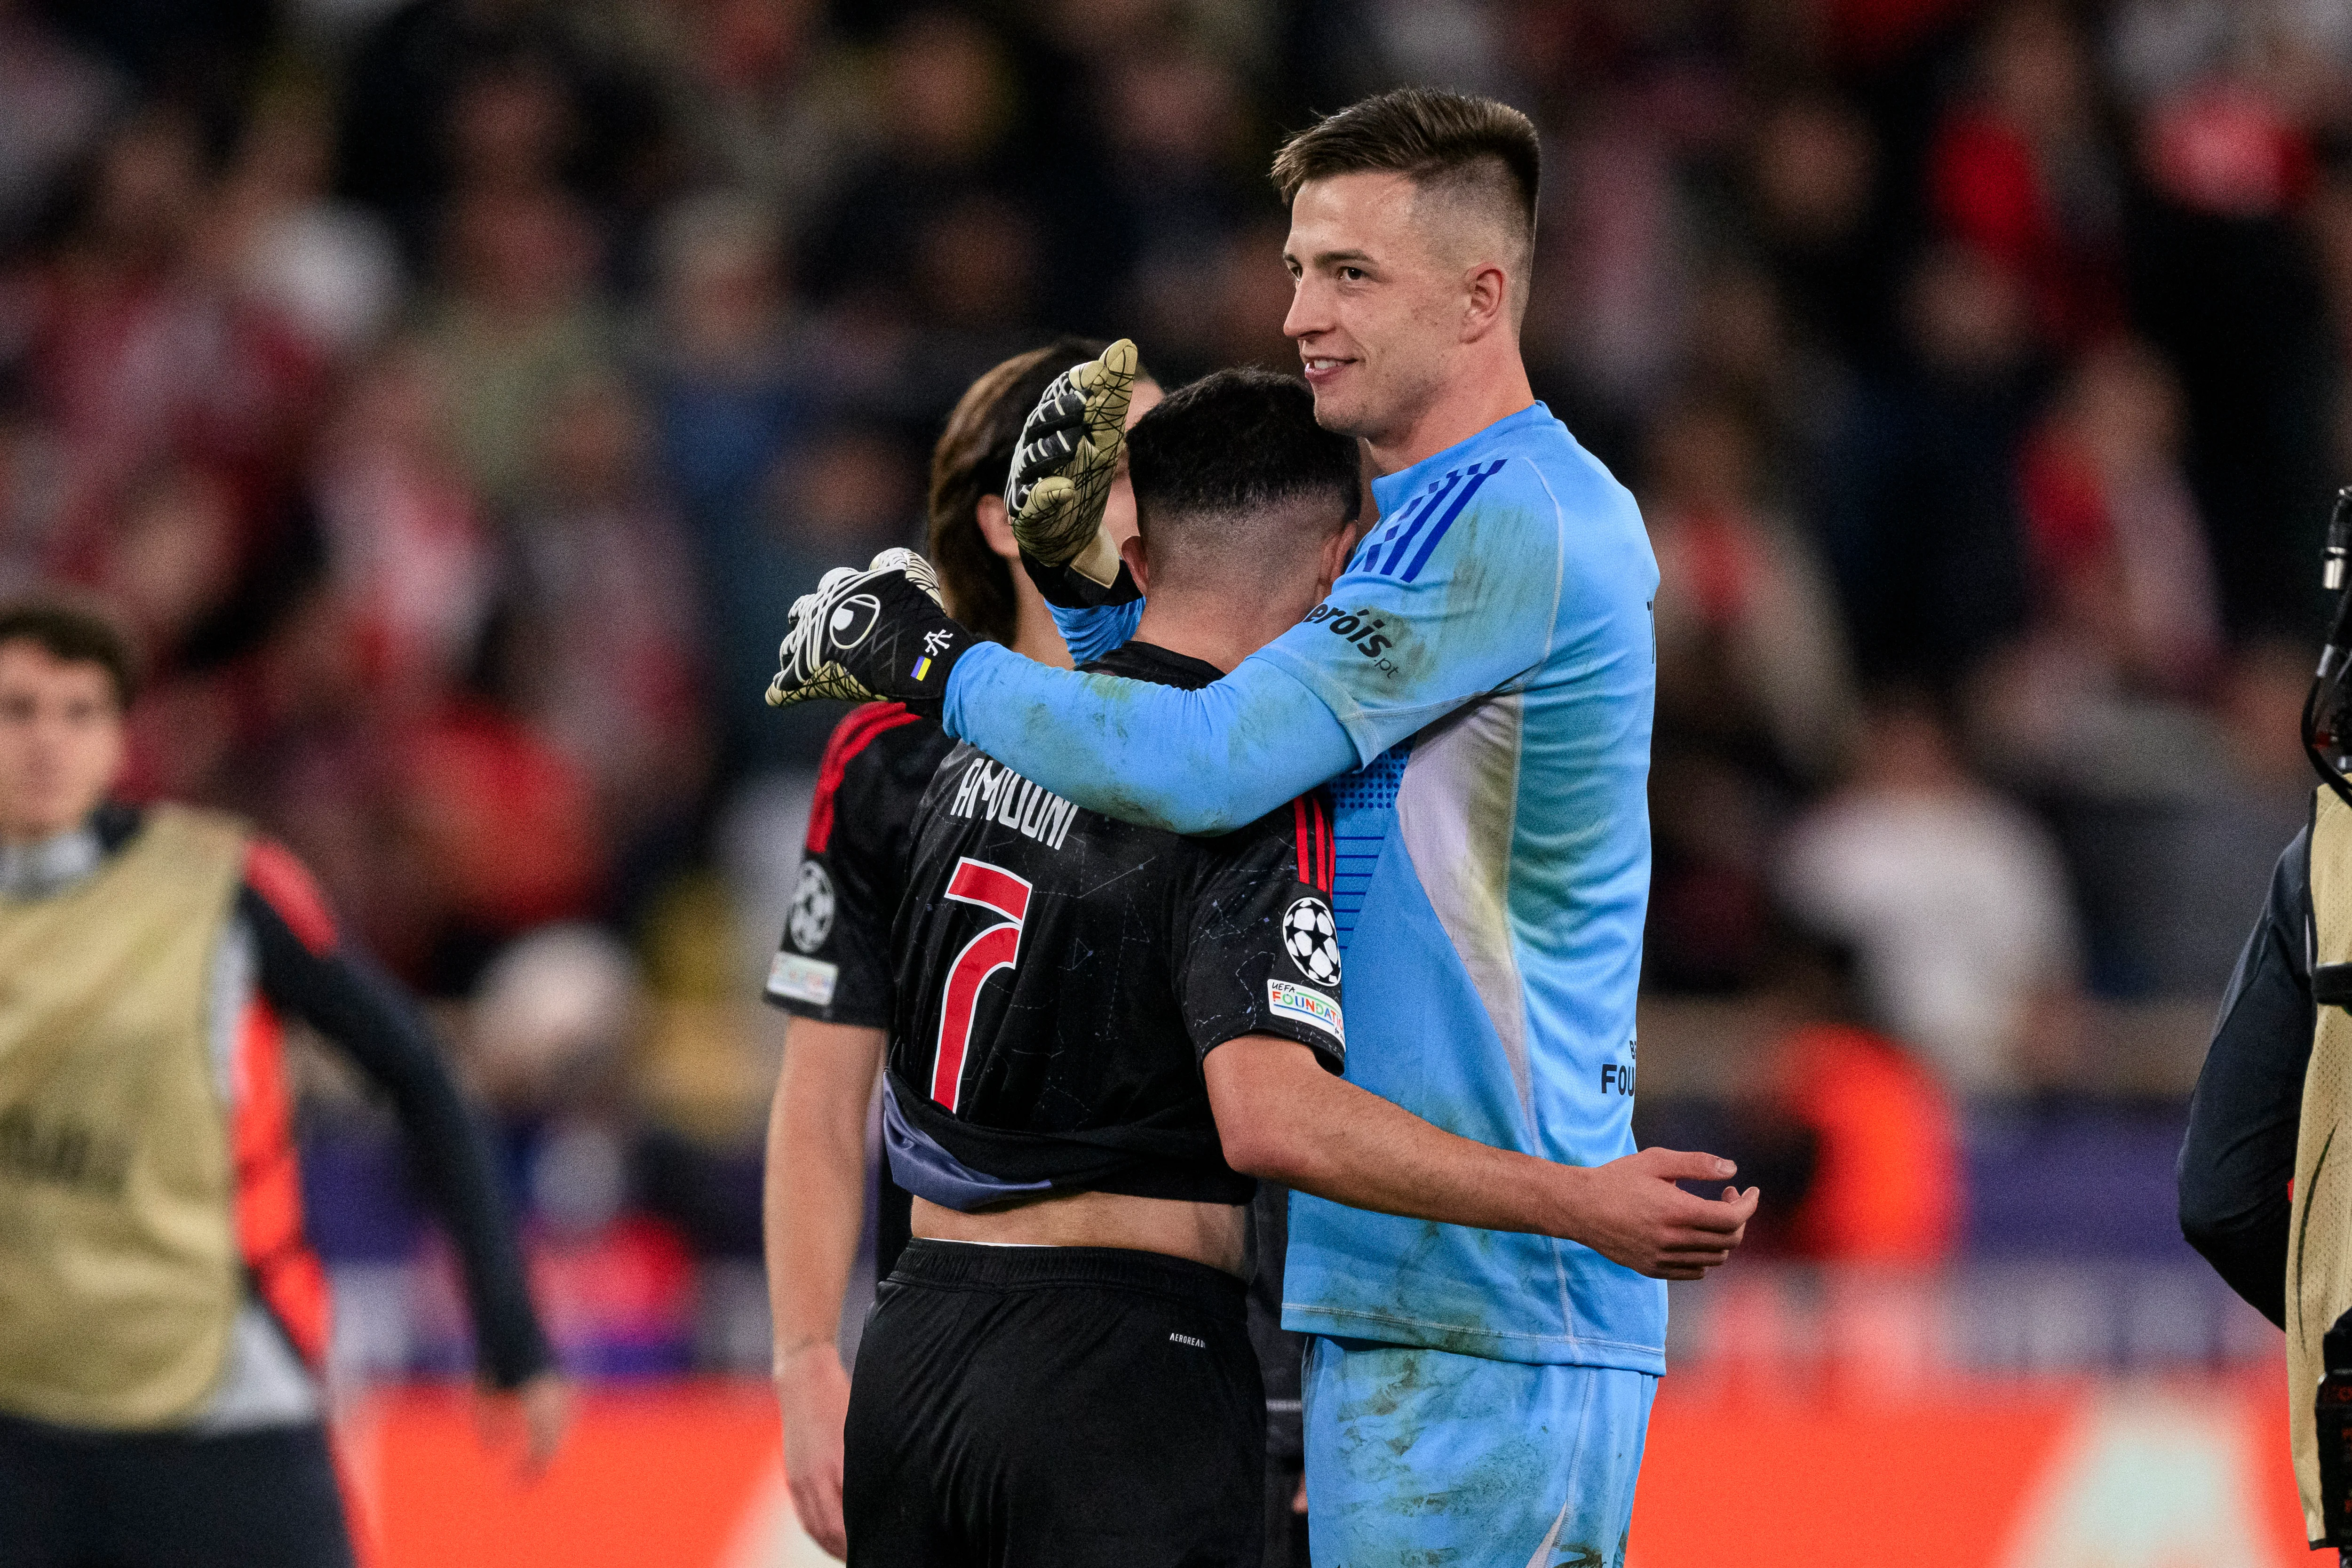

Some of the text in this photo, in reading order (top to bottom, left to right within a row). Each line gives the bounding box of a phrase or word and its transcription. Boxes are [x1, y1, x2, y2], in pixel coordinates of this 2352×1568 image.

[930, 856, 1033, 1114] 7
[1271, 982, 1295, 993] UEFA
[1601, 1064, 1635, 1097] FOU
